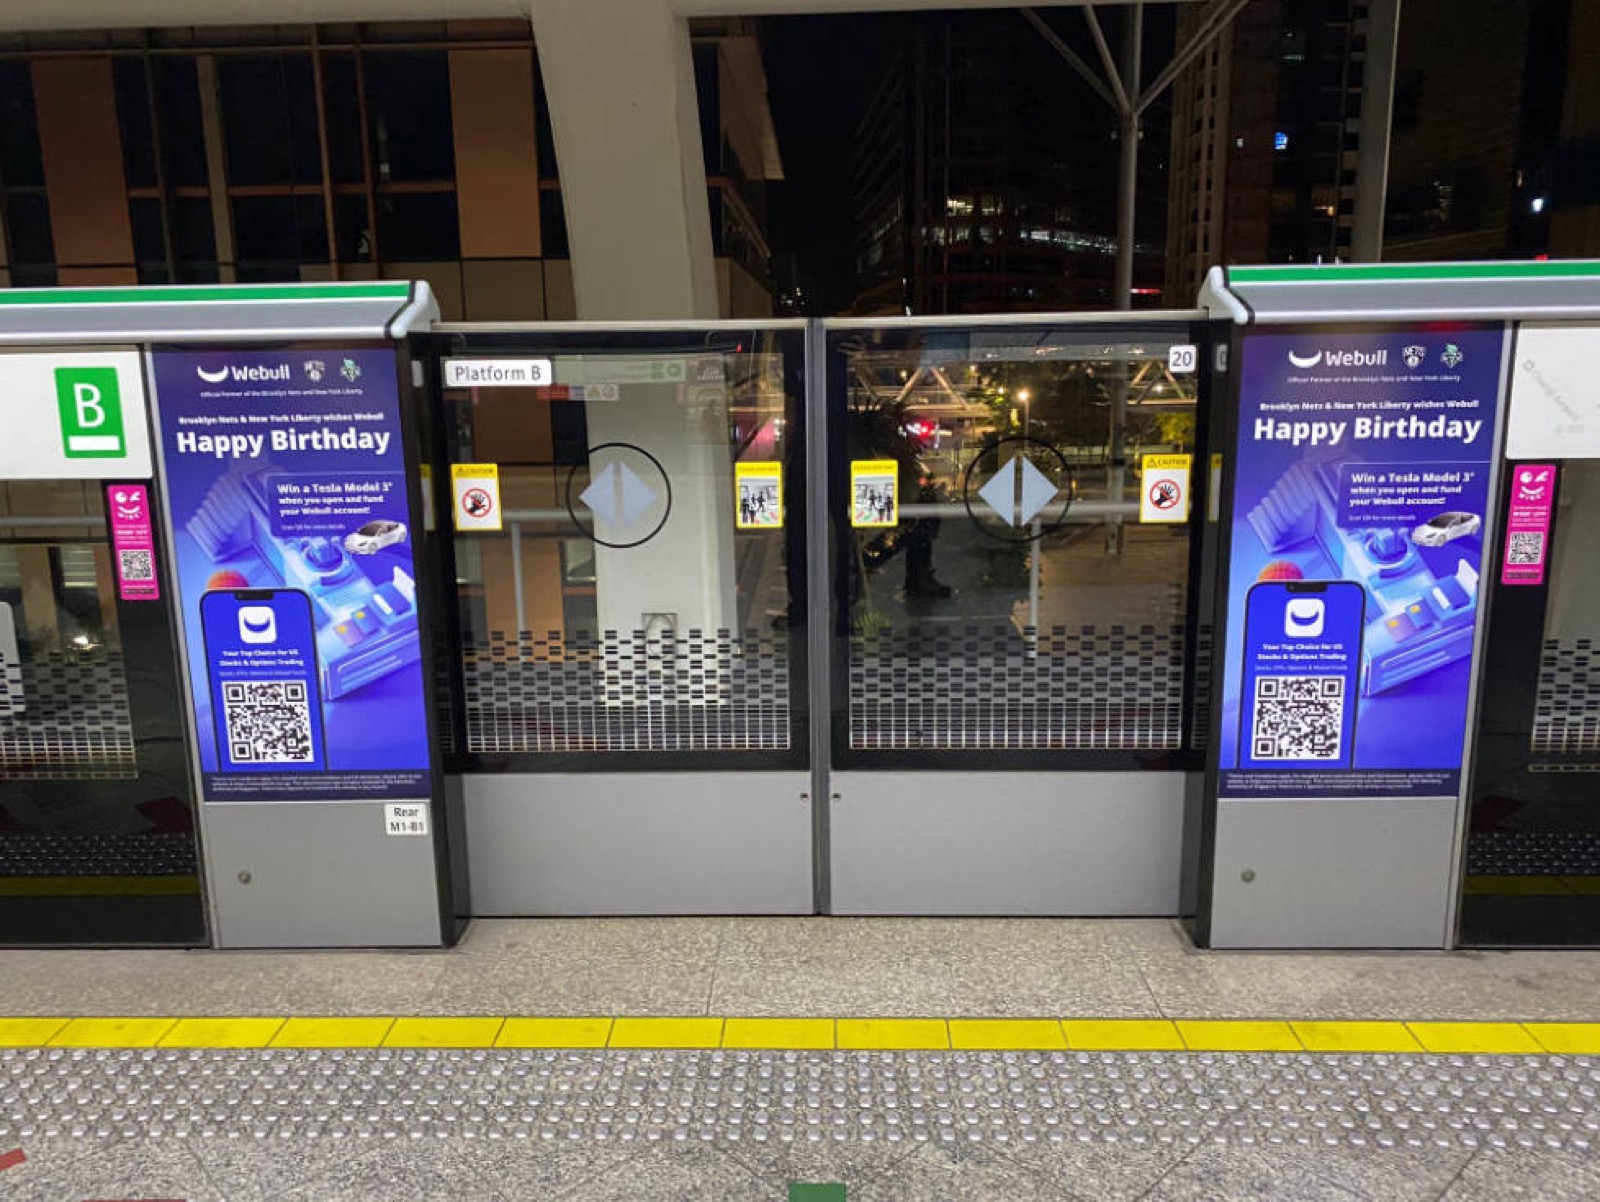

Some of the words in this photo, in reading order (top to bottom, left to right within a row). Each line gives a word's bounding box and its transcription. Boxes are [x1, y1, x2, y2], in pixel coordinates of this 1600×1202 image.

[1172, 351, 1192, 366] 20
[1325, 350, 1387, 366] Webull
[231, 364, 290, 381] Webull
[455, 365, 526, 381] Platform
[531, 365, 541, 381] B
[74, 383, 105, 428] B
[1260, 402, 1299, 412] Brooklyn
[1301, 402, 1323, 410] Nets
[1325, 402, 1332, 410] &
[1334, 401, 1354, 410] New
[1356, 401, 1378, 410] York
[1379, 401, 1412, 411] Liberty
[1413, 400, 1445, 408] wishes
[1446, 399, 1480, 408] Webull
[178, 416, 218, 425] Brooklyn
[218, 415, 238, 424] Nets
[269, 414, 289, 423] York
[290, 413, 322, 424] Liberty
[353, 411, 384, 421] Webull
[1254, 418, 1347, 446] Happy
[1354, 414, 1482, 443] Birthday
[176, 431, 264, 458] Happy
[271, 426, 390, 455] Birthday
[1351, 472, 1375, 483] Win
[1378, 474, 1386, 483] a
[1389, 472, 1420, 482] Tesla
[1422, 471, 1460, 482] Model
[276, 484, 300, 494] Win
[303, 485, 310, 493] a
[311, 483, 342, 493] Tesla
[344, 482, 380, 492] Model
[1350, 486, 1376, 494] when
[1377, 487, 1395, 496] you
[1396, 486, 1419, 495] open
[1440, 485, 1462, 493] fund
[278, 497, 303, 505] when
[304, 497, 320, 506] you
[321, 496, 344, 505] open
[362, 494, 384, 503] fund
[1349, 498, 1370, 507] your
[1372, 497, 1405, 505] Webull
[279, 509, 300, 518] your
[301, 507, 331, 515] Webull
[393, 807, 419, 817] Rear
